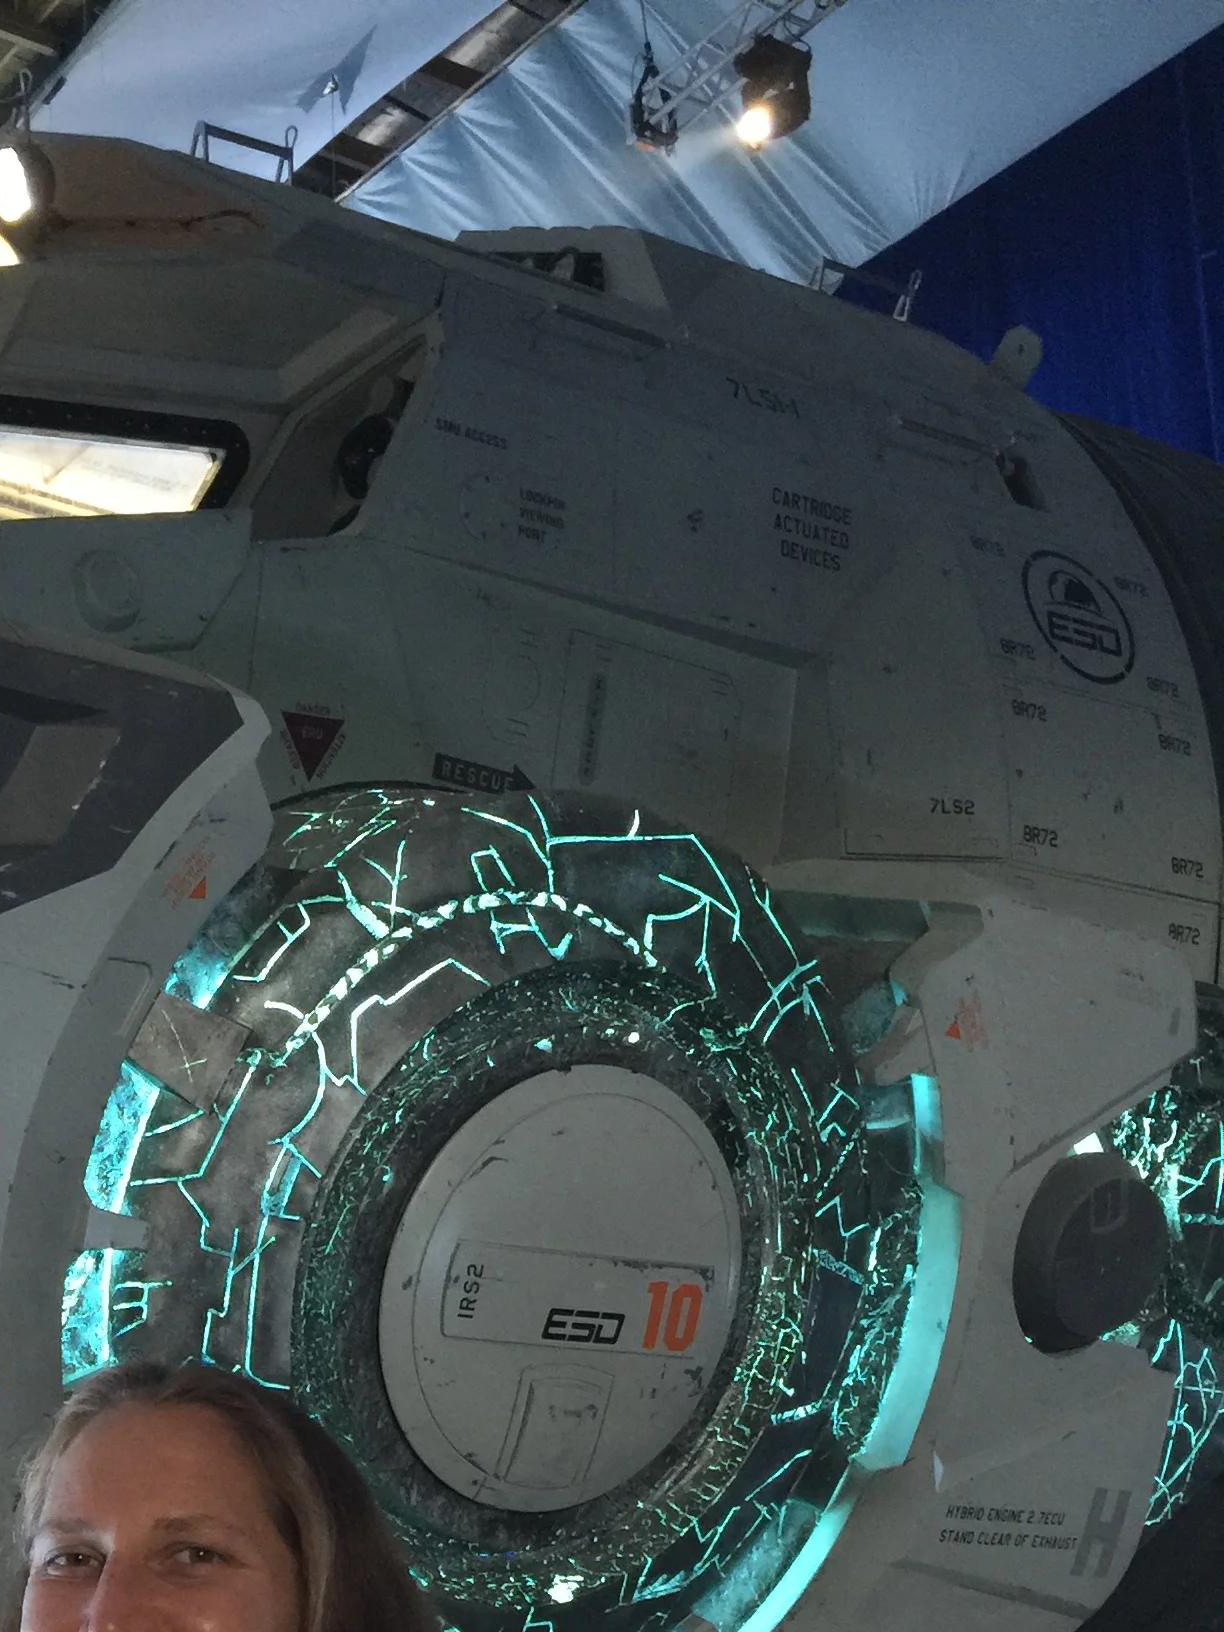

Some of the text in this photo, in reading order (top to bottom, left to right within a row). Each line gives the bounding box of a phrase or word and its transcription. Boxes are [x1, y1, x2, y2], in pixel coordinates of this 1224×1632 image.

[772, 486, 853, 526] CARTRIDGE
[774, 512, 850, 549] ACTUATED
[780, 539, 841, 572] DEVICES
[1046, 610, 1122, 658] ESD
[456, 1263, 485, 1320] IRS2
[541, 1280, 704, 1352] ESD 10
[946, 1504, 985, 1522] HYBRID
[987, 1507, 1024, 1524] ENGINE
[939, 1529, 1078, 1550] STAND CLEAR OF EXHAUST
